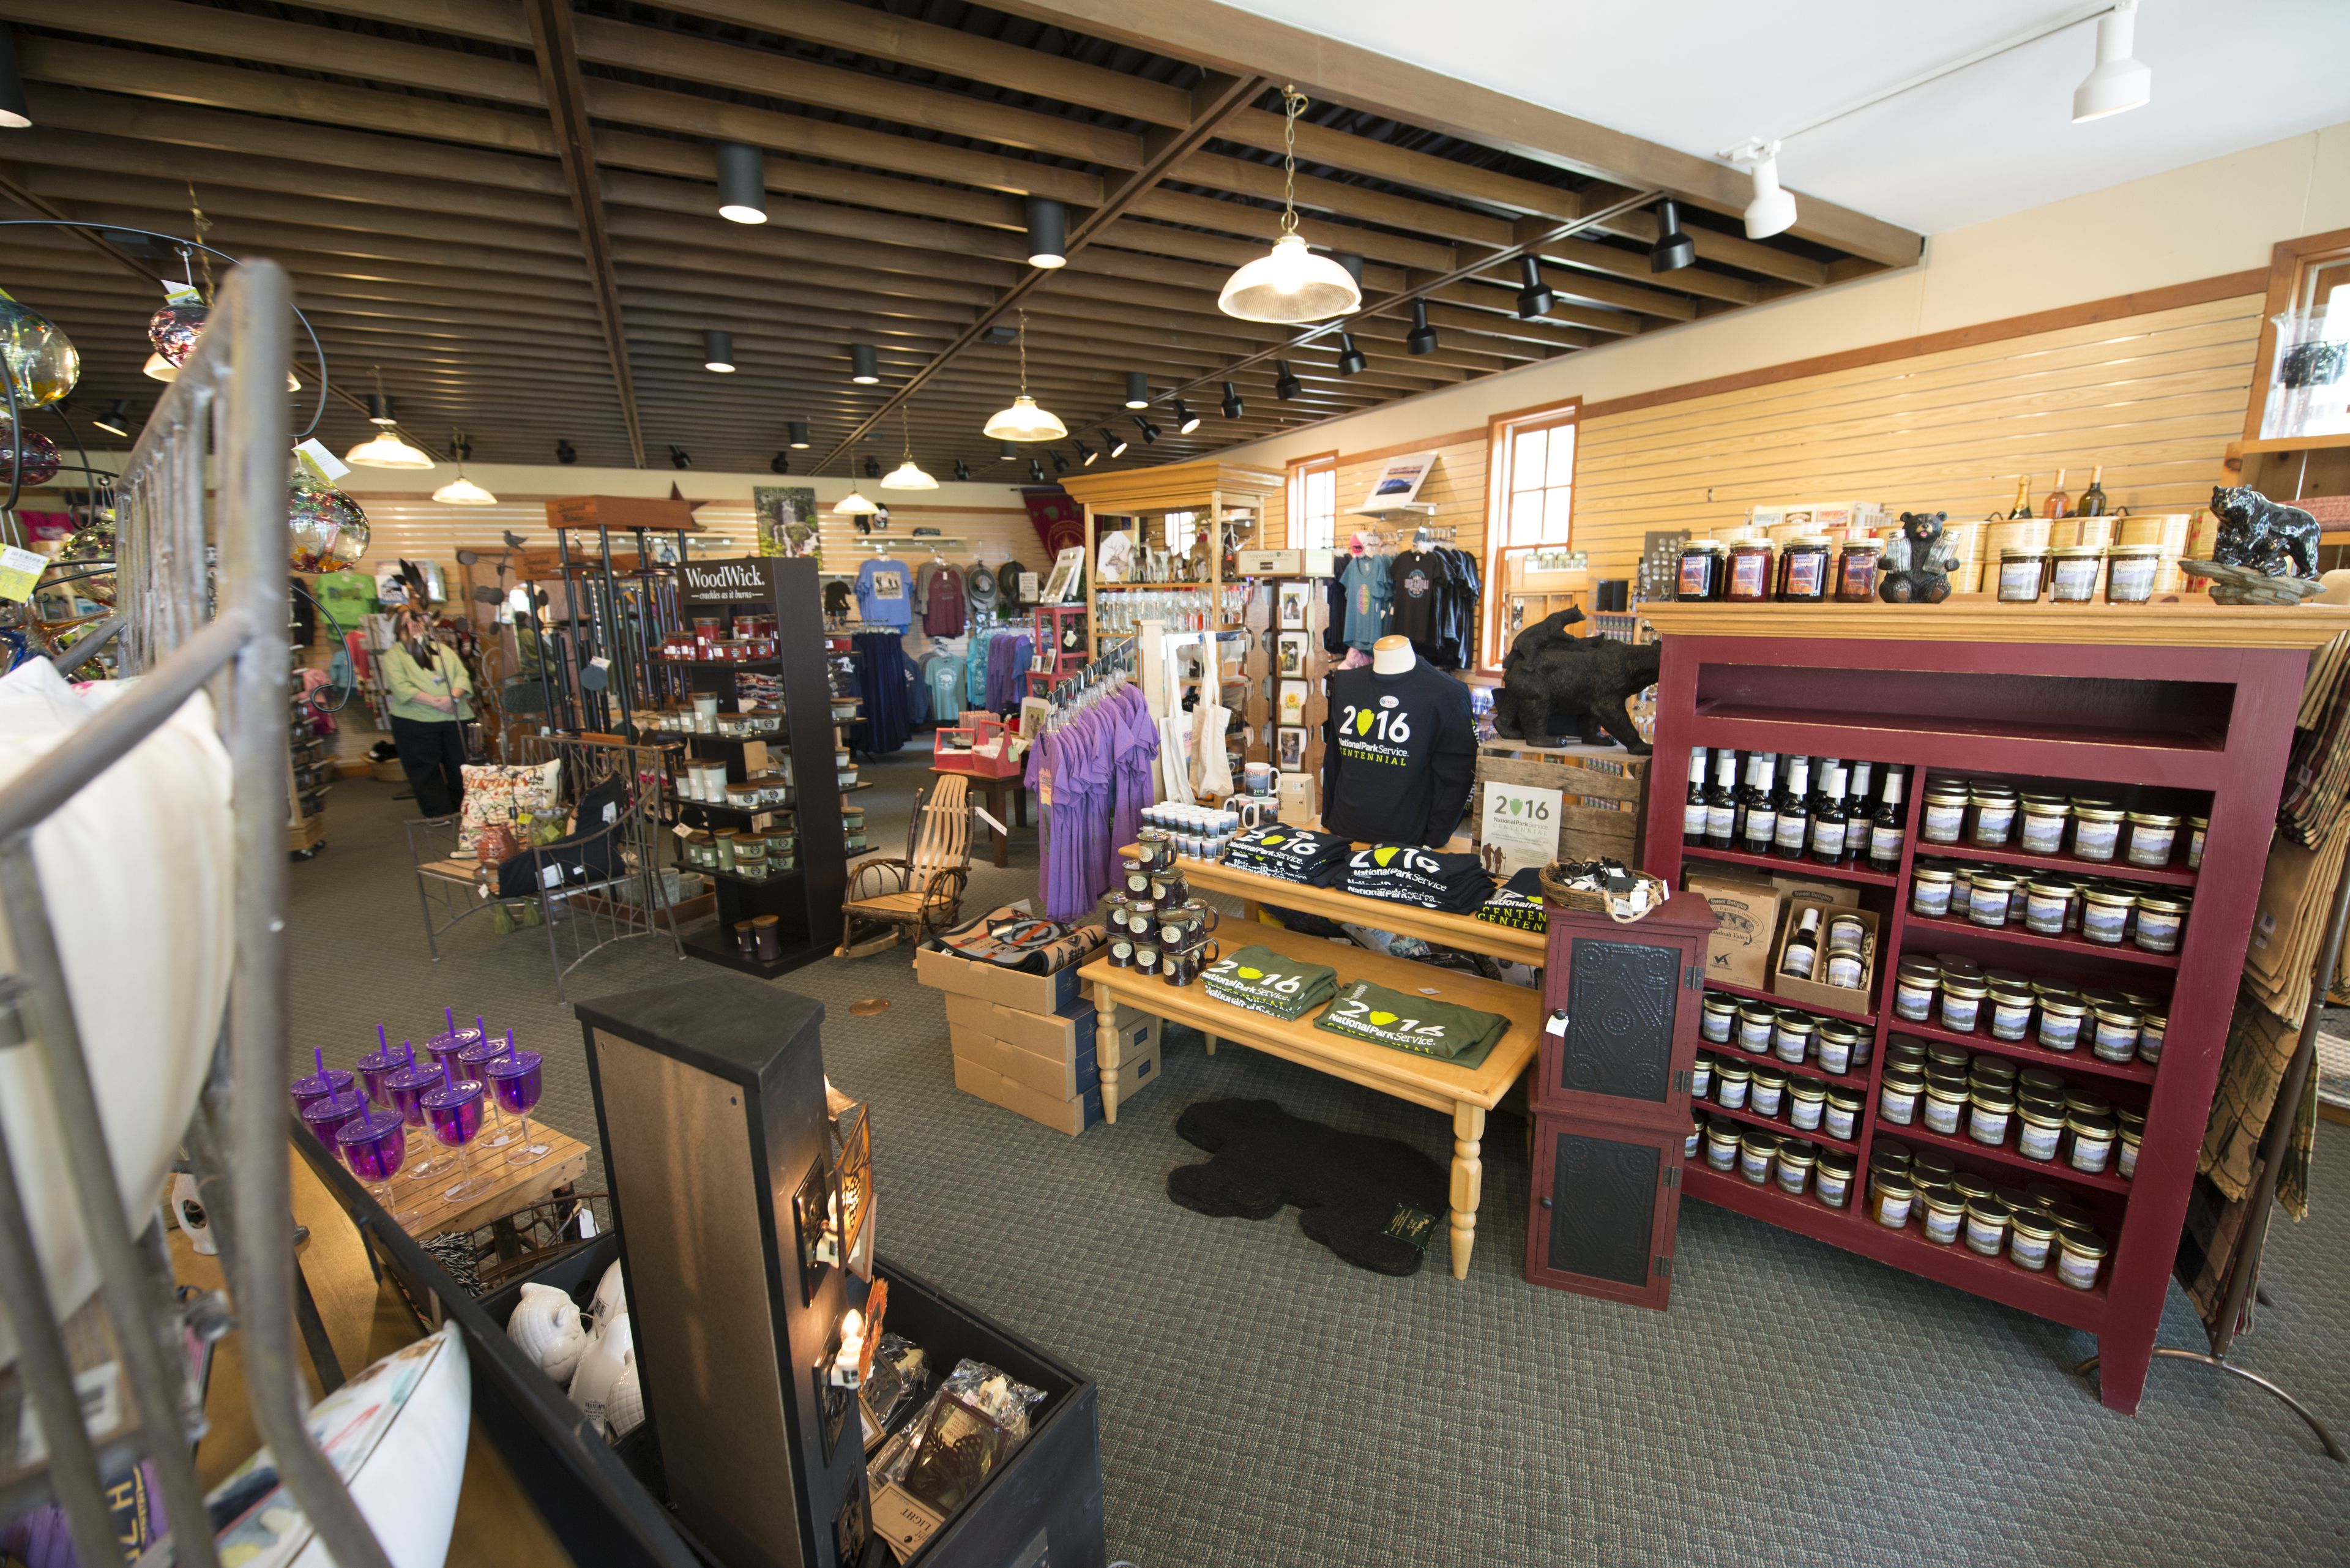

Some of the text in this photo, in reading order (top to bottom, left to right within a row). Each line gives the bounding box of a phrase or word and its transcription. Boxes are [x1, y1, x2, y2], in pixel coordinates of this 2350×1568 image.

[699, 590, 720, 600] crackles
[729, 589, 734, 599] it
[734, 589, 753, 599] burns
[1340, 747, 1406, 766] CENTENNIAL
[1493, 823, 1548, 836] CENTENNIAL
[1726, 900, 1748, 909] Delights
[1811, 892, 1832, 902] Delights
[1477, 913, 1543, 931] CENTEN
[1482, 906, 1546, 922] CENTEN
[1737, 909, 1760, 927] Company
[900, 1508, 931, 1531] LIGHT
